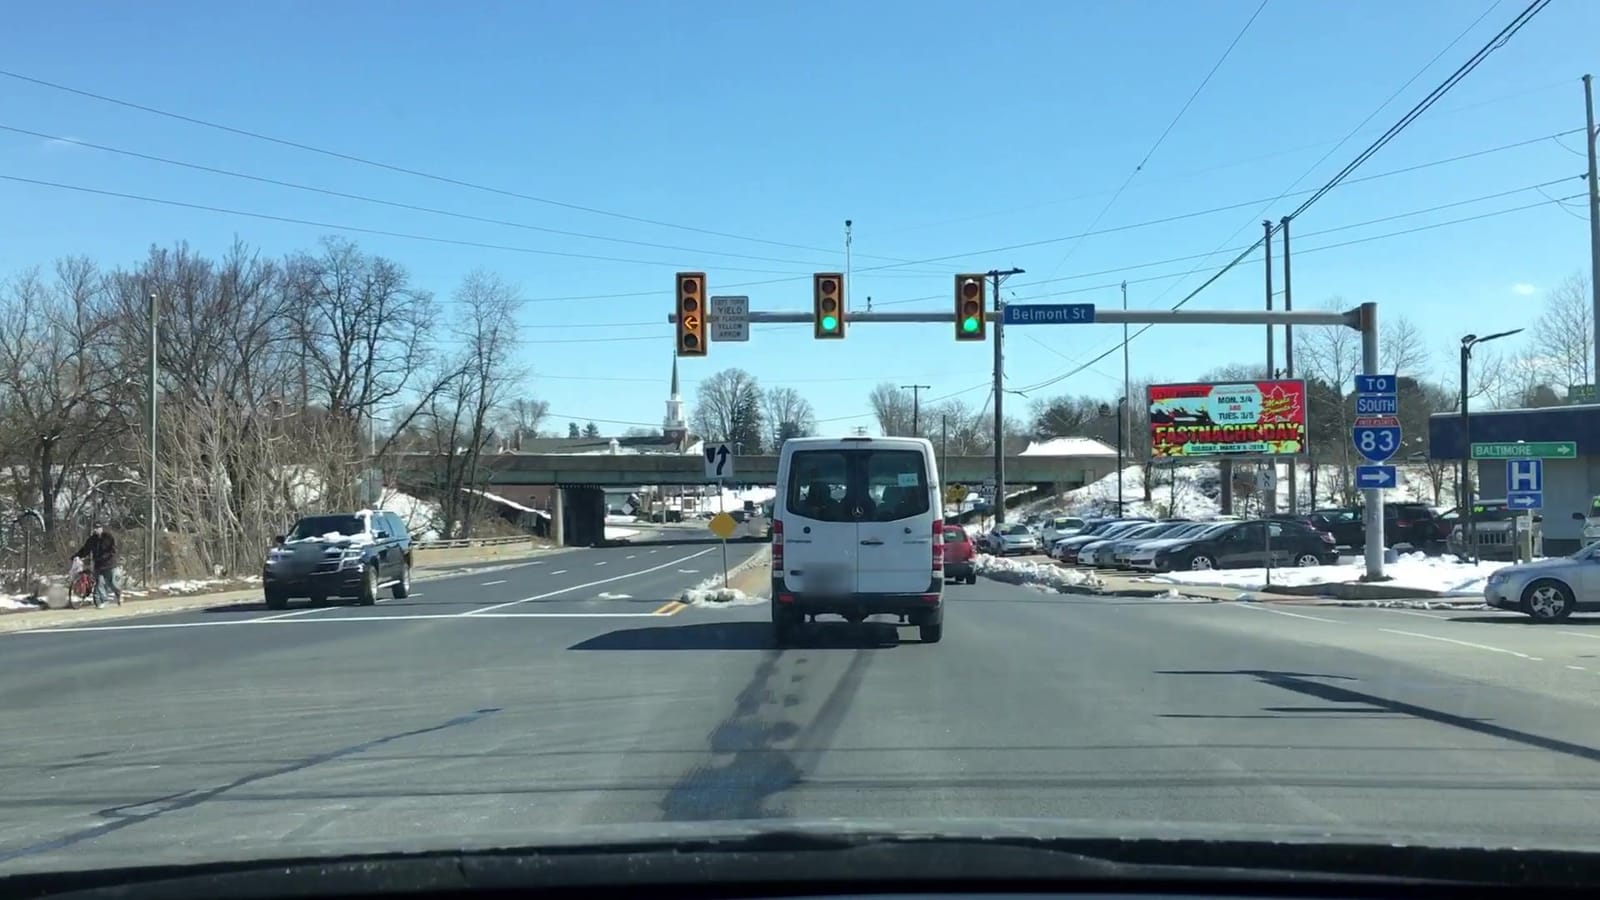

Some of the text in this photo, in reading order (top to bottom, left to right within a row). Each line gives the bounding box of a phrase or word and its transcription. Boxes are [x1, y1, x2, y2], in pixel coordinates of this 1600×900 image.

[717, 306, 742, 314] YIELD
[1012, 307, 1085, 320] Belmont St
[1365, 378, 1386, 390] TO
[1359, 399, 1395, 412] SOUTH
[1361, 430, 1393, 451] 83
[1476, 445, 1532, 455] BALTIMORE
[1511, 462, 1537, 489] H
